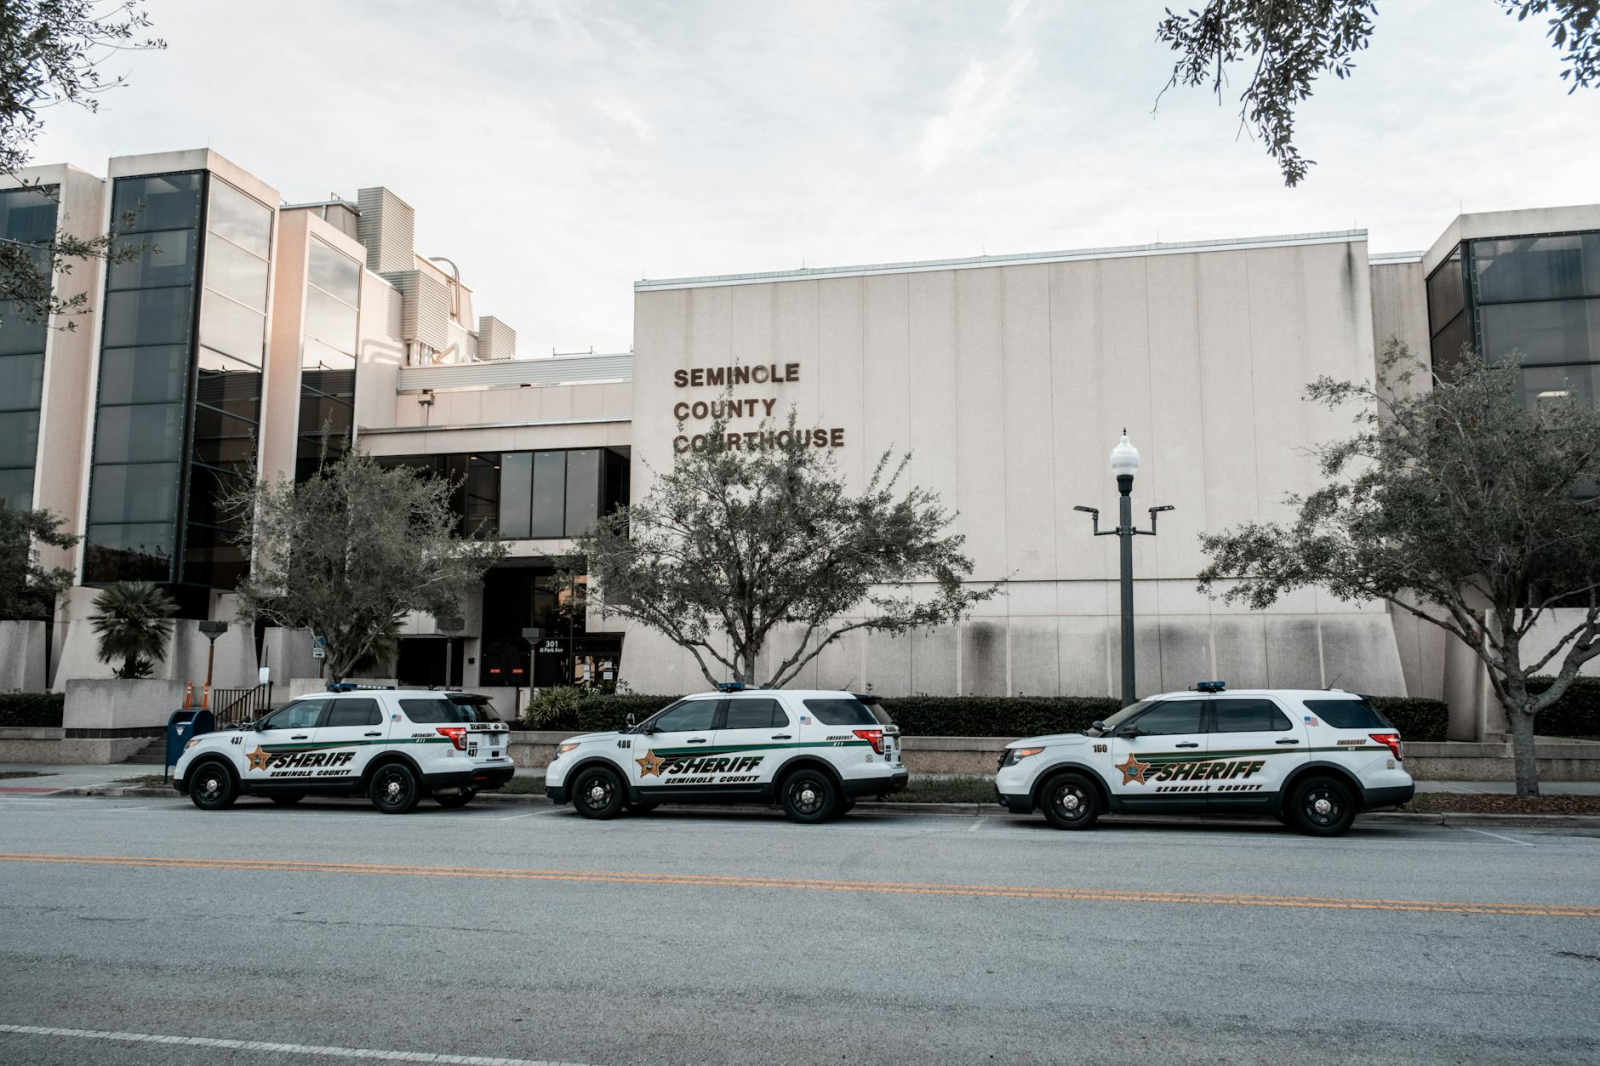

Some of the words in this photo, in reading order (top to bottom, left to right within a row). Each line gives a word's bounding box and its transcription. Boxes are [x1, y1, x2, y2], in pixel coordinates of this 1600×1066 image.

[674, 363, 800, 387] SEMINOLE
[674, 398, 777, 420] COUNTY
[1092, 744, 1108, 753] 160
[273, 752, 357, 768] SHERIFF
[668, 756, 764, 774] SHERIFF
[665, 776, 715, 784] SEMINOLE
[719, 775, 760, 783] COUNTY
[1155, 760, 1266, 782] SHERIFF
[1155, 785, 1211, 793] SEMINOLE
[1217, 784, 1263, 792] COUNTY
